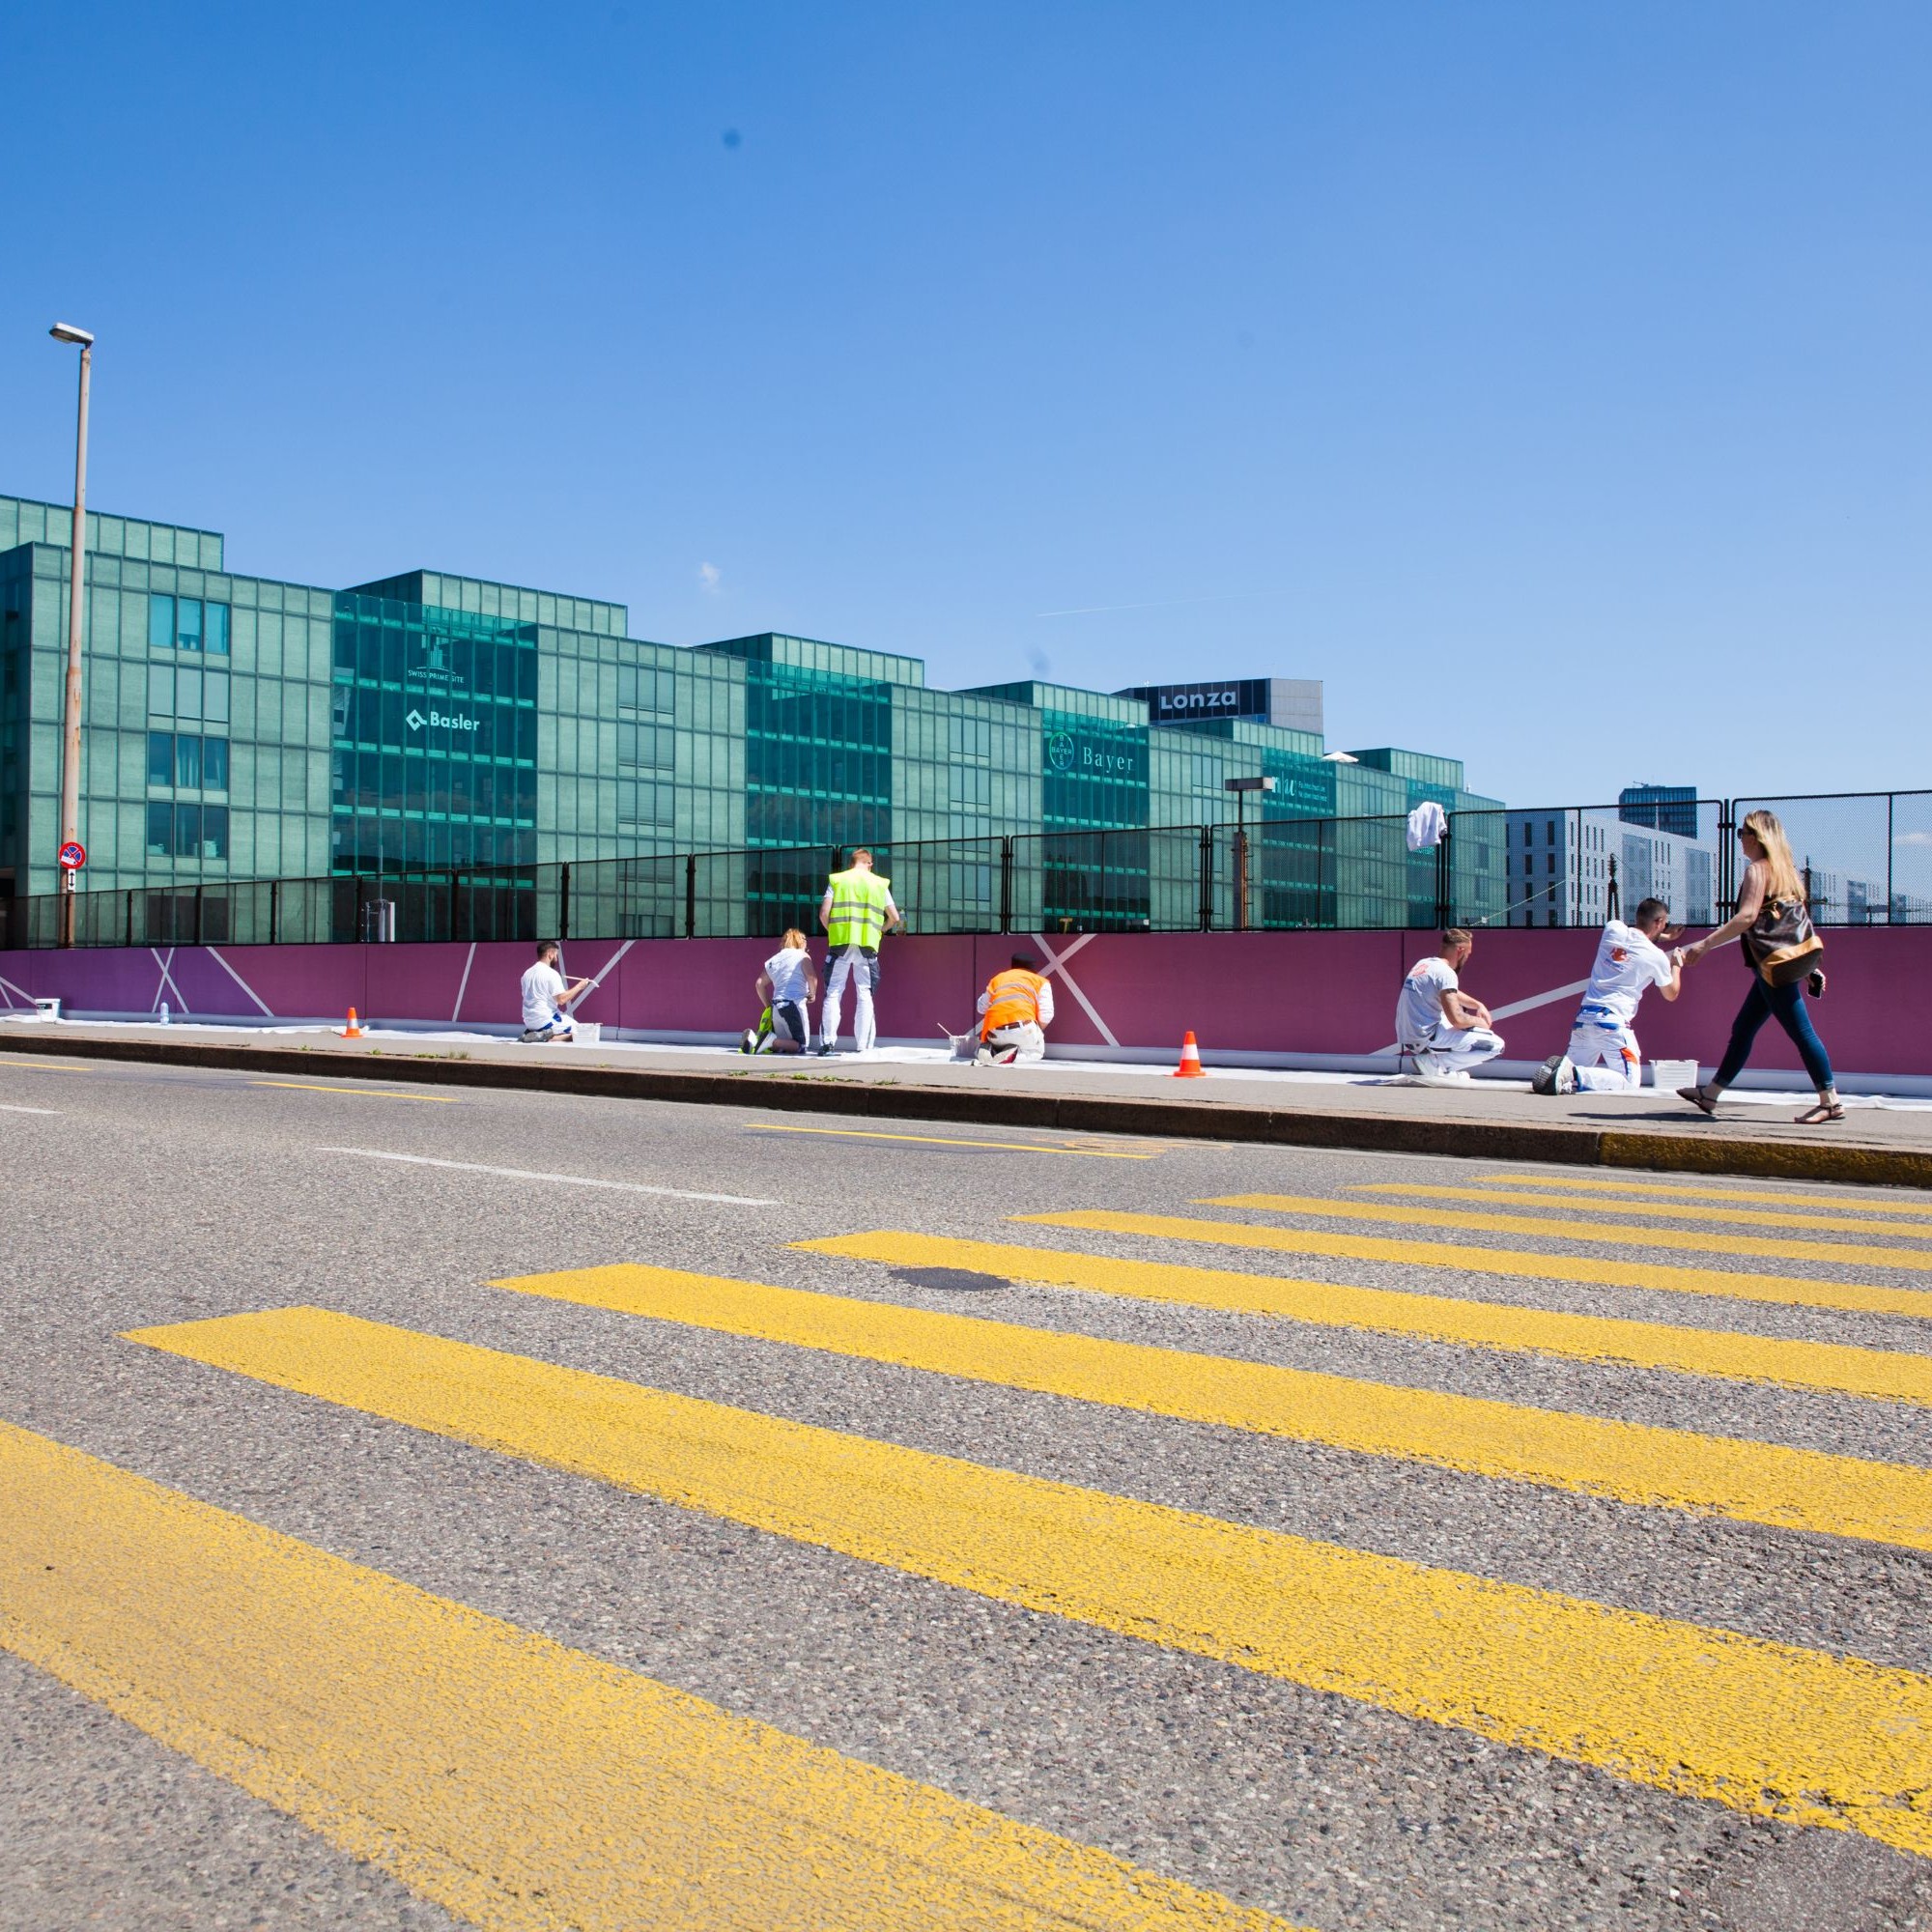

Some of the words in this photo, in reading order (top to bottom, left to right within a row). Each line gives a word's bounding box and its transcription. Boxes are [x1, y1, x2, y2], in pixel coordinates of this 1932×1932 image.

[408, 669, 427, 678] SWISS
[428, 672, 449, 682] PRIME
[1160, 691, 1236, 710] Lonza
[430, 710, 480, 731] Basler
[1051, 746, 1072, 755] BAYER
[1083, 746, 1134, 774] Bayer
